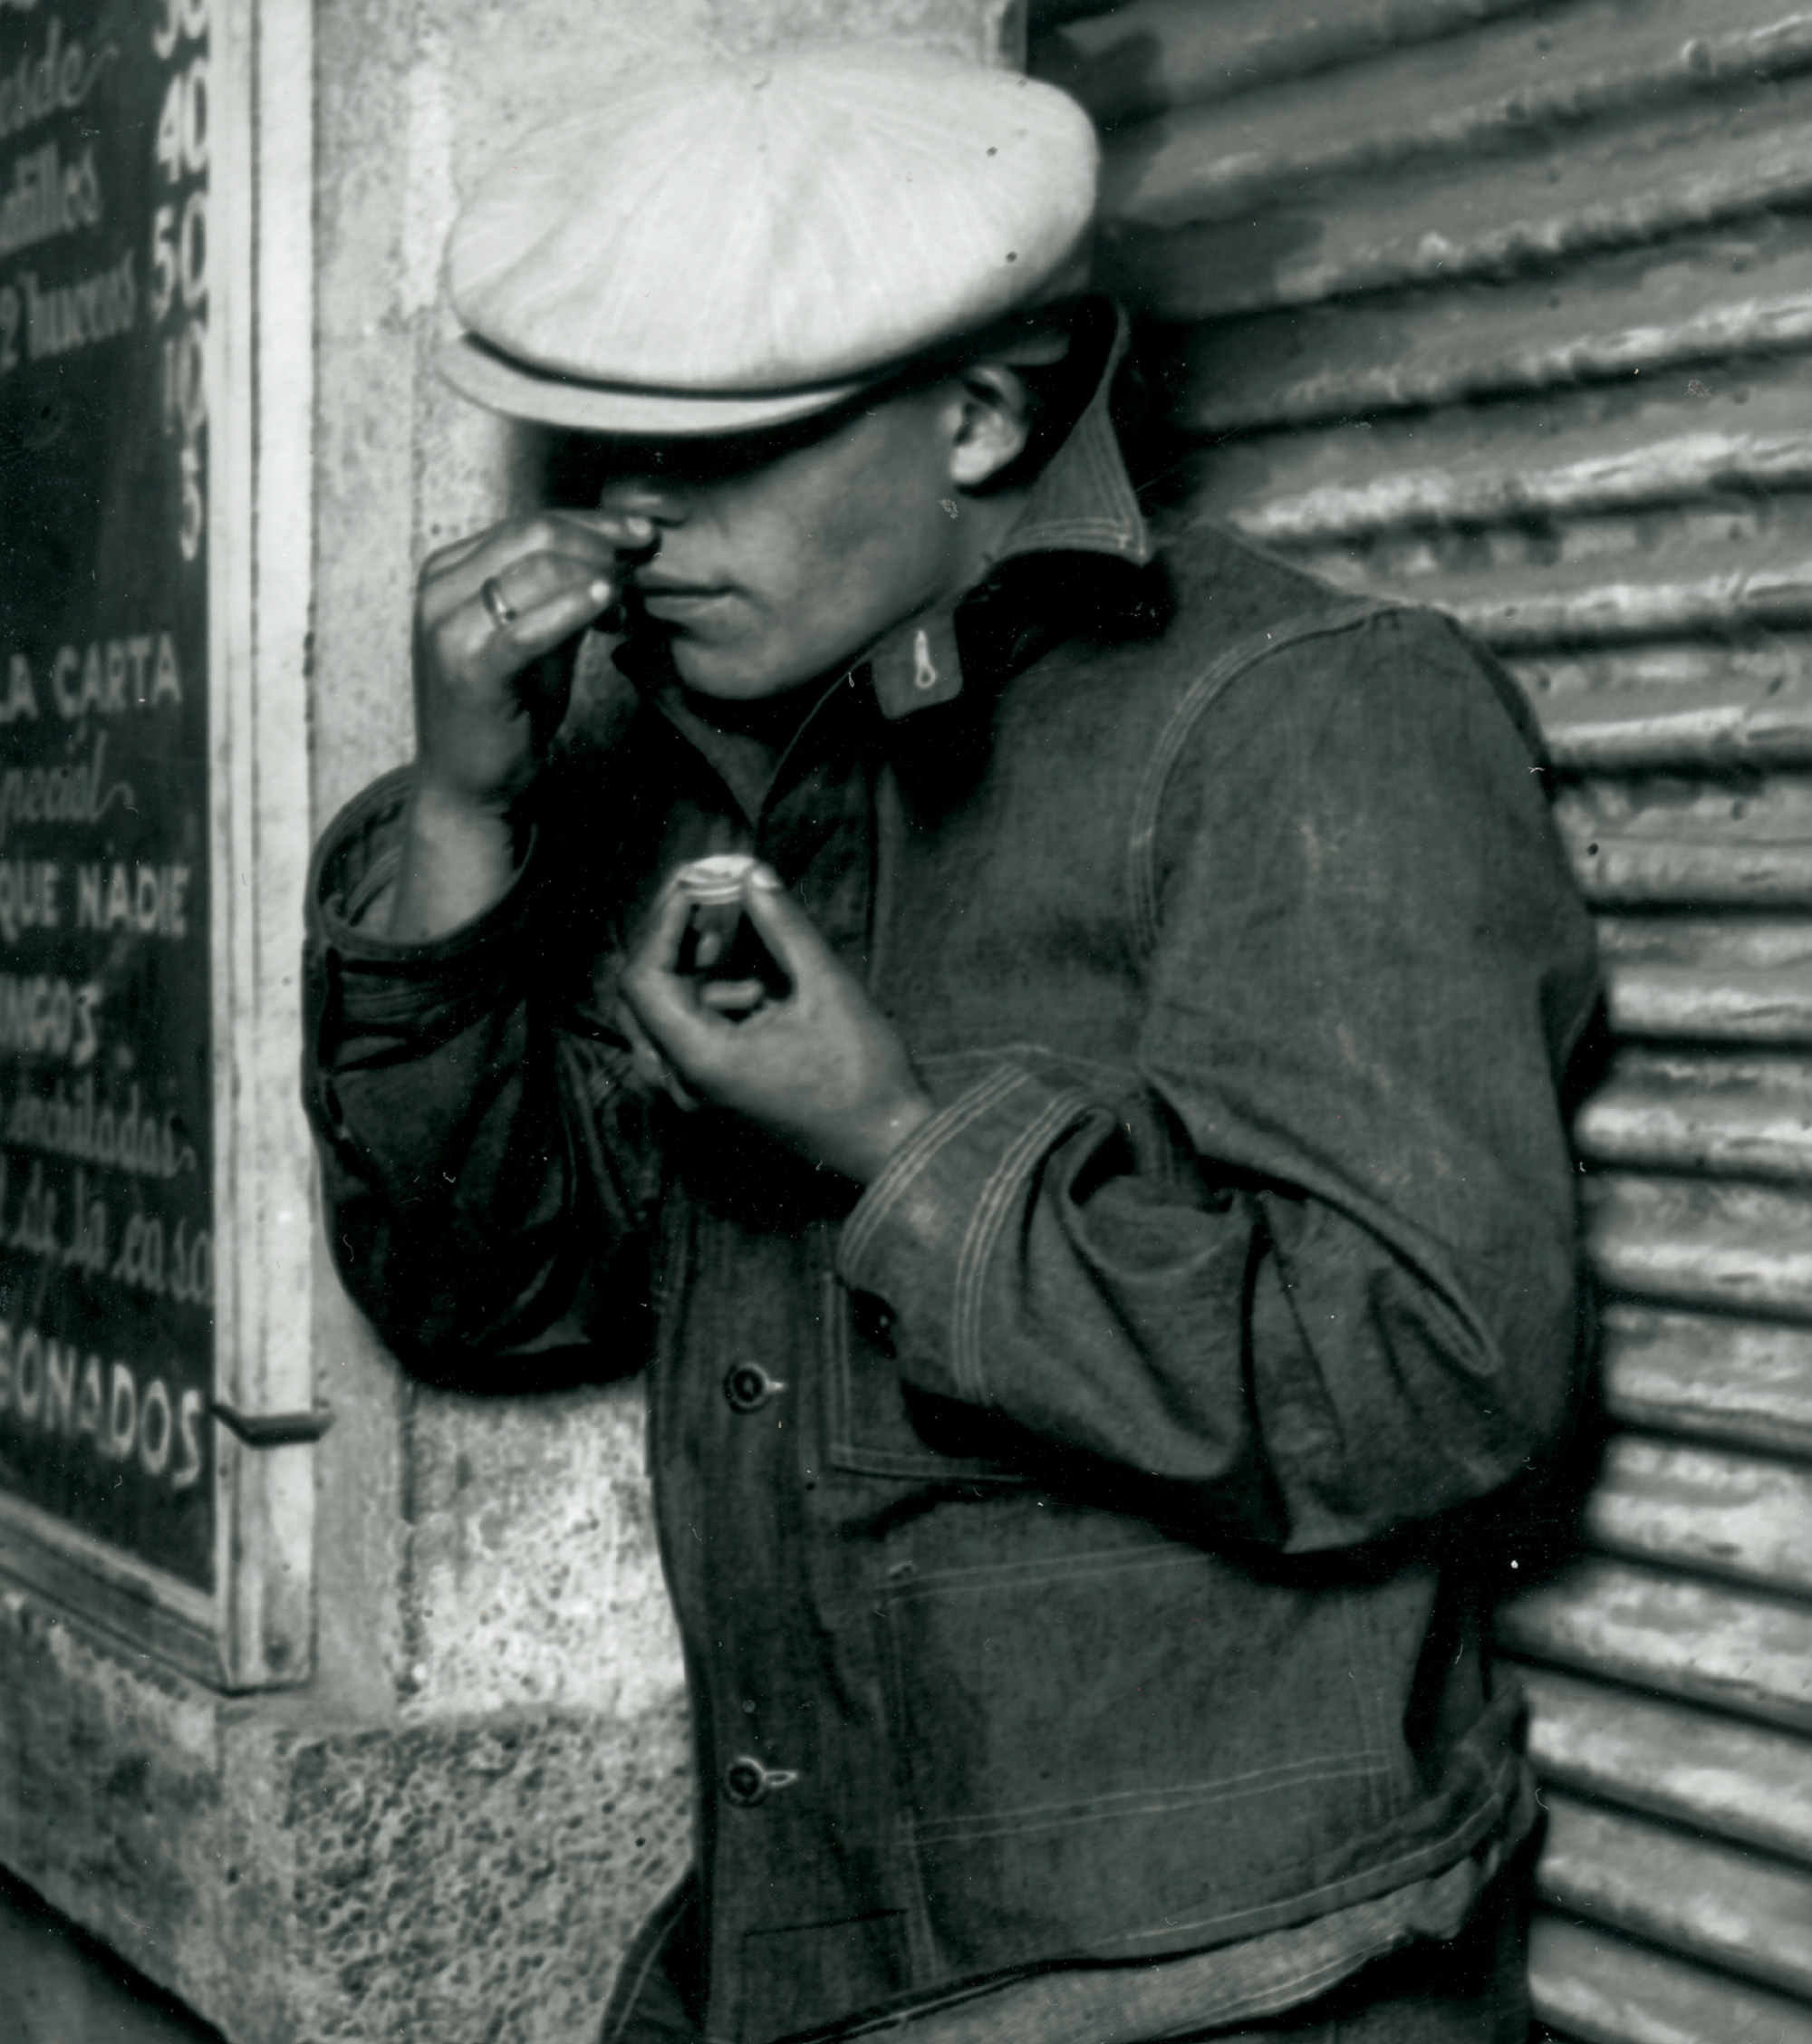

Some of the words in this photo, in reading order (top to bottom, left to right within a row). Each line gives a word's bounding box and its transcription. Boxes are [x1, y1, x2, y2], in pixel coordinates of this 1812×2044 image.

[151, 58, 208, 184] 40
[147, 192, 208, 328] 50
[53, 629, 183, 721] CARTA
[76, 859, 193, 940] NADIE
